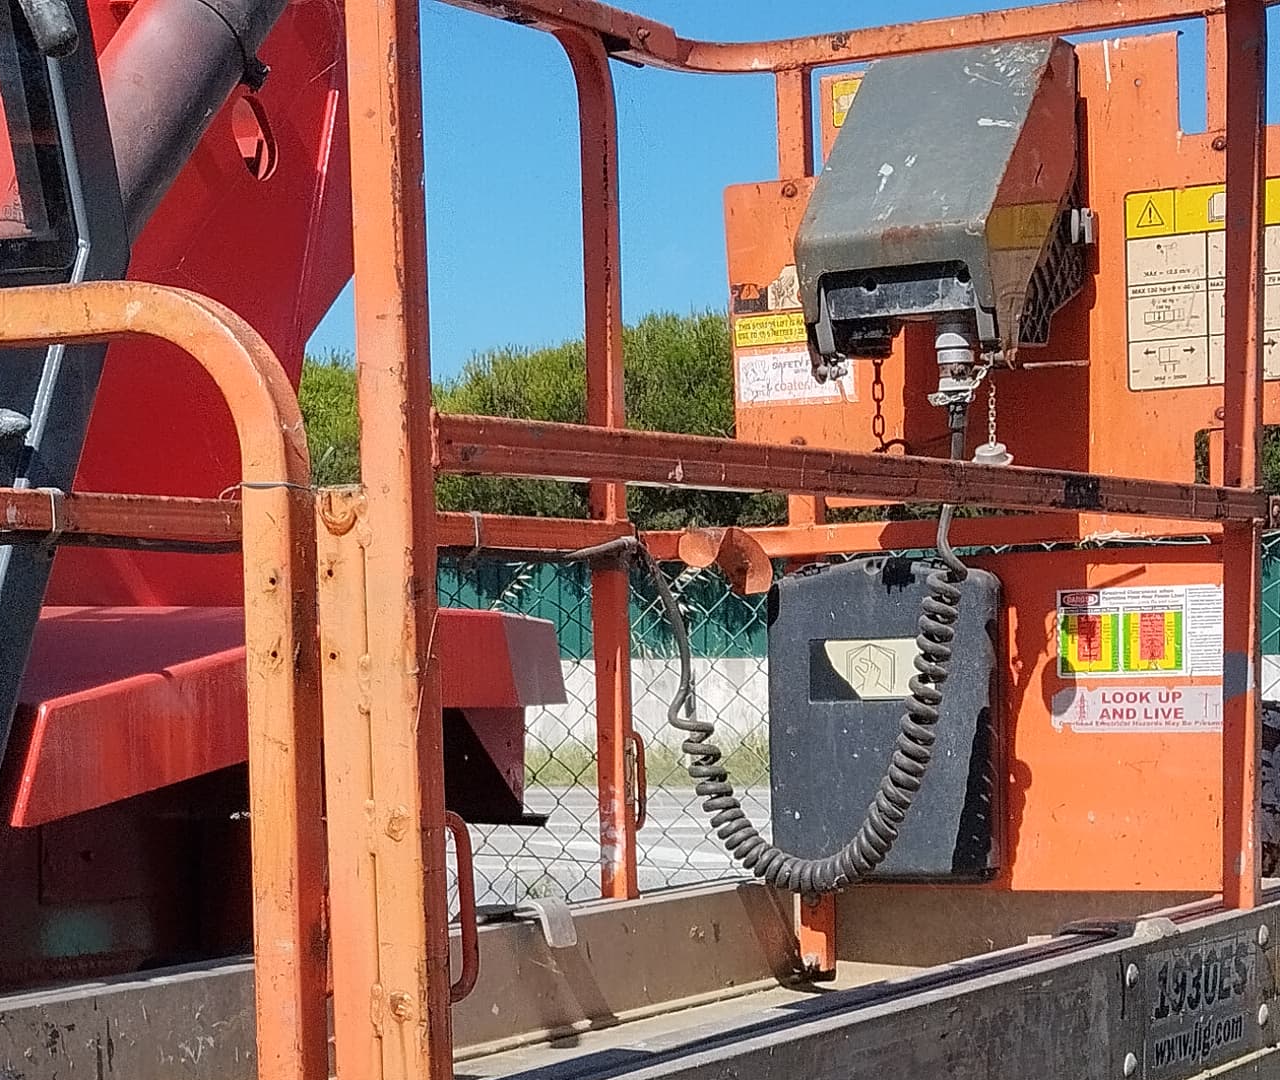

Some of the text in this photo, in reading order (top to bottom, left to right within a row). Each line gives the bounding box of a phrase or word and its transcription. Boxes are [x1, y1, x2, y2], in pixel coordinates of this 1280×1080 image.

[1101, 691, 1182, 704] LOOK UP
[1099, 706, 1184, 720] AND LIVE
[1153, 944, 1249, 1019] 1930ES
